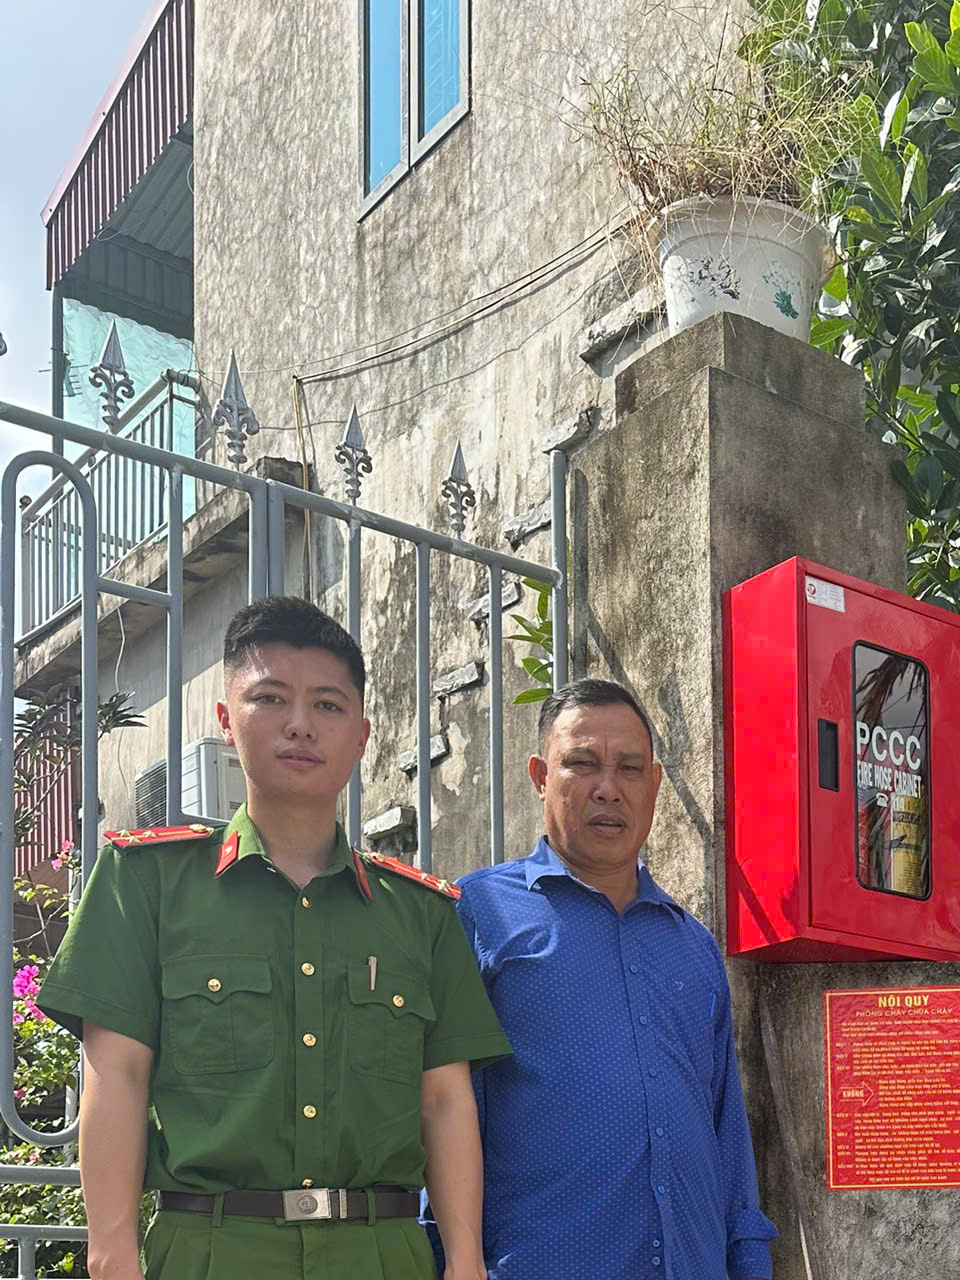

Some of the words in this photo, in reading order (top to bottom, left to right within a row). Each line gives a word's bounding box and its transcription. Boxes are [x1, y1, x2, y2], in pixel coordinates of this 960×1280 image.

[856, 720, 921, 770] PCCC
[856, 760, 873, 788] FIRE
[874, 765, 893, 792] HOSE
[894, 769, 922, 799] CABINET
[878, 994, 900, 1009] NỘI
[904, 995, 929, 1007] QUY
